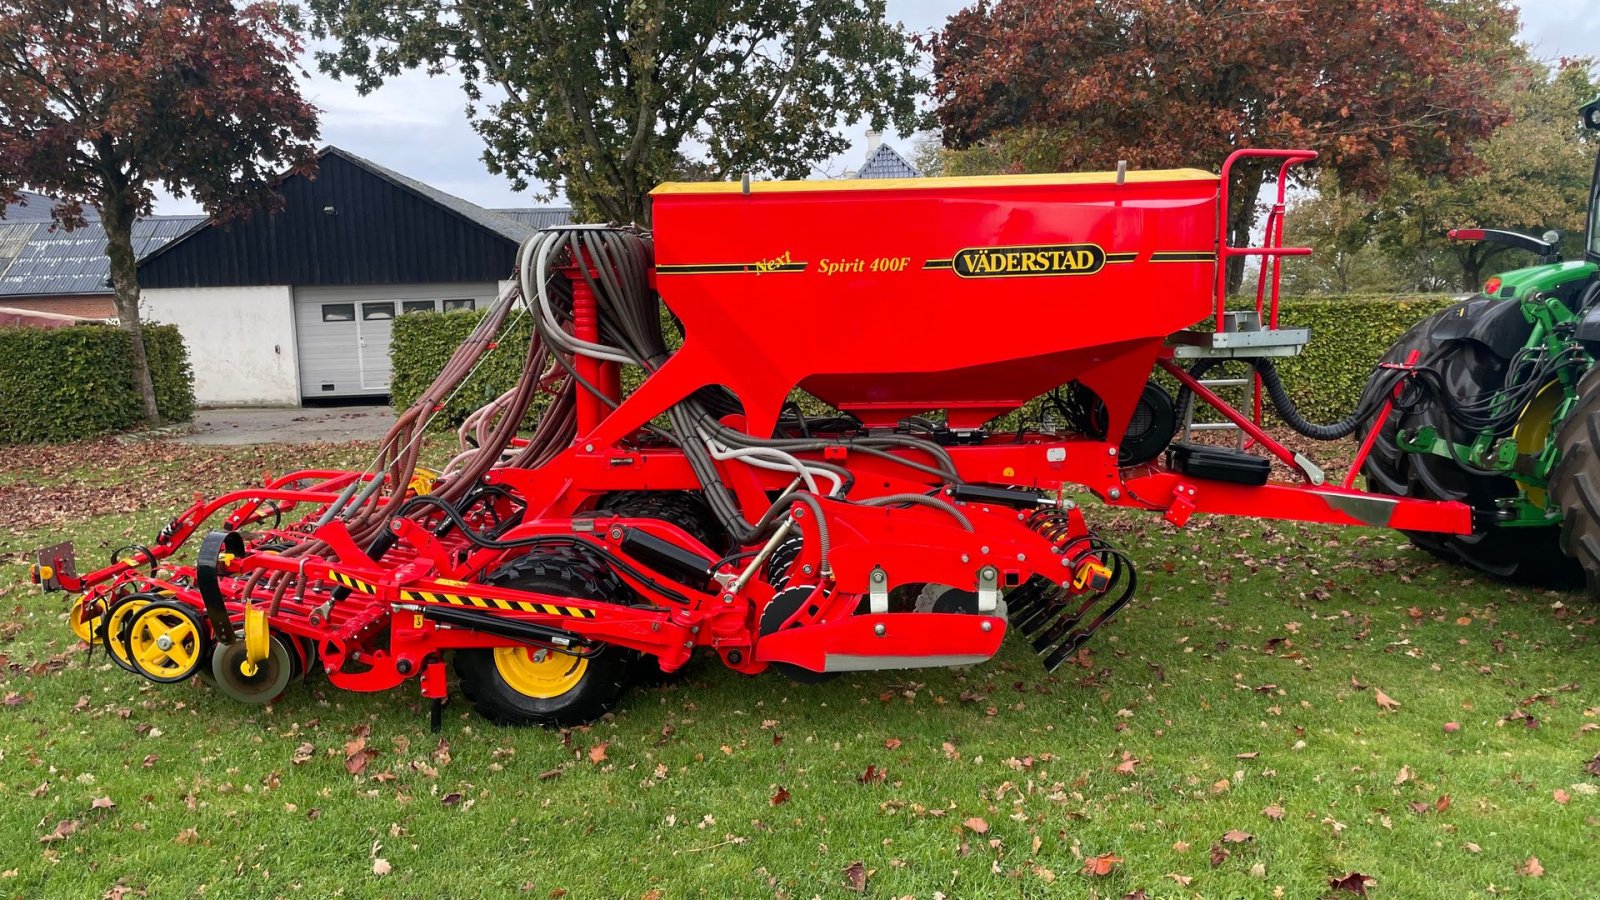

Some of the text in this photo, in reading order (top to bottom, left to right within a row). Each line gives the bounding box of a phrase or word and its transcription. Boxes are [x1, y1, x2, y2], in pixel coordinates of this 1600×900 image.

[755, 250, 792, 276] Next
[817, 257, 911, 276] Spirit 400F
[963, 249, 1094, 273] VÄDERSTAD
